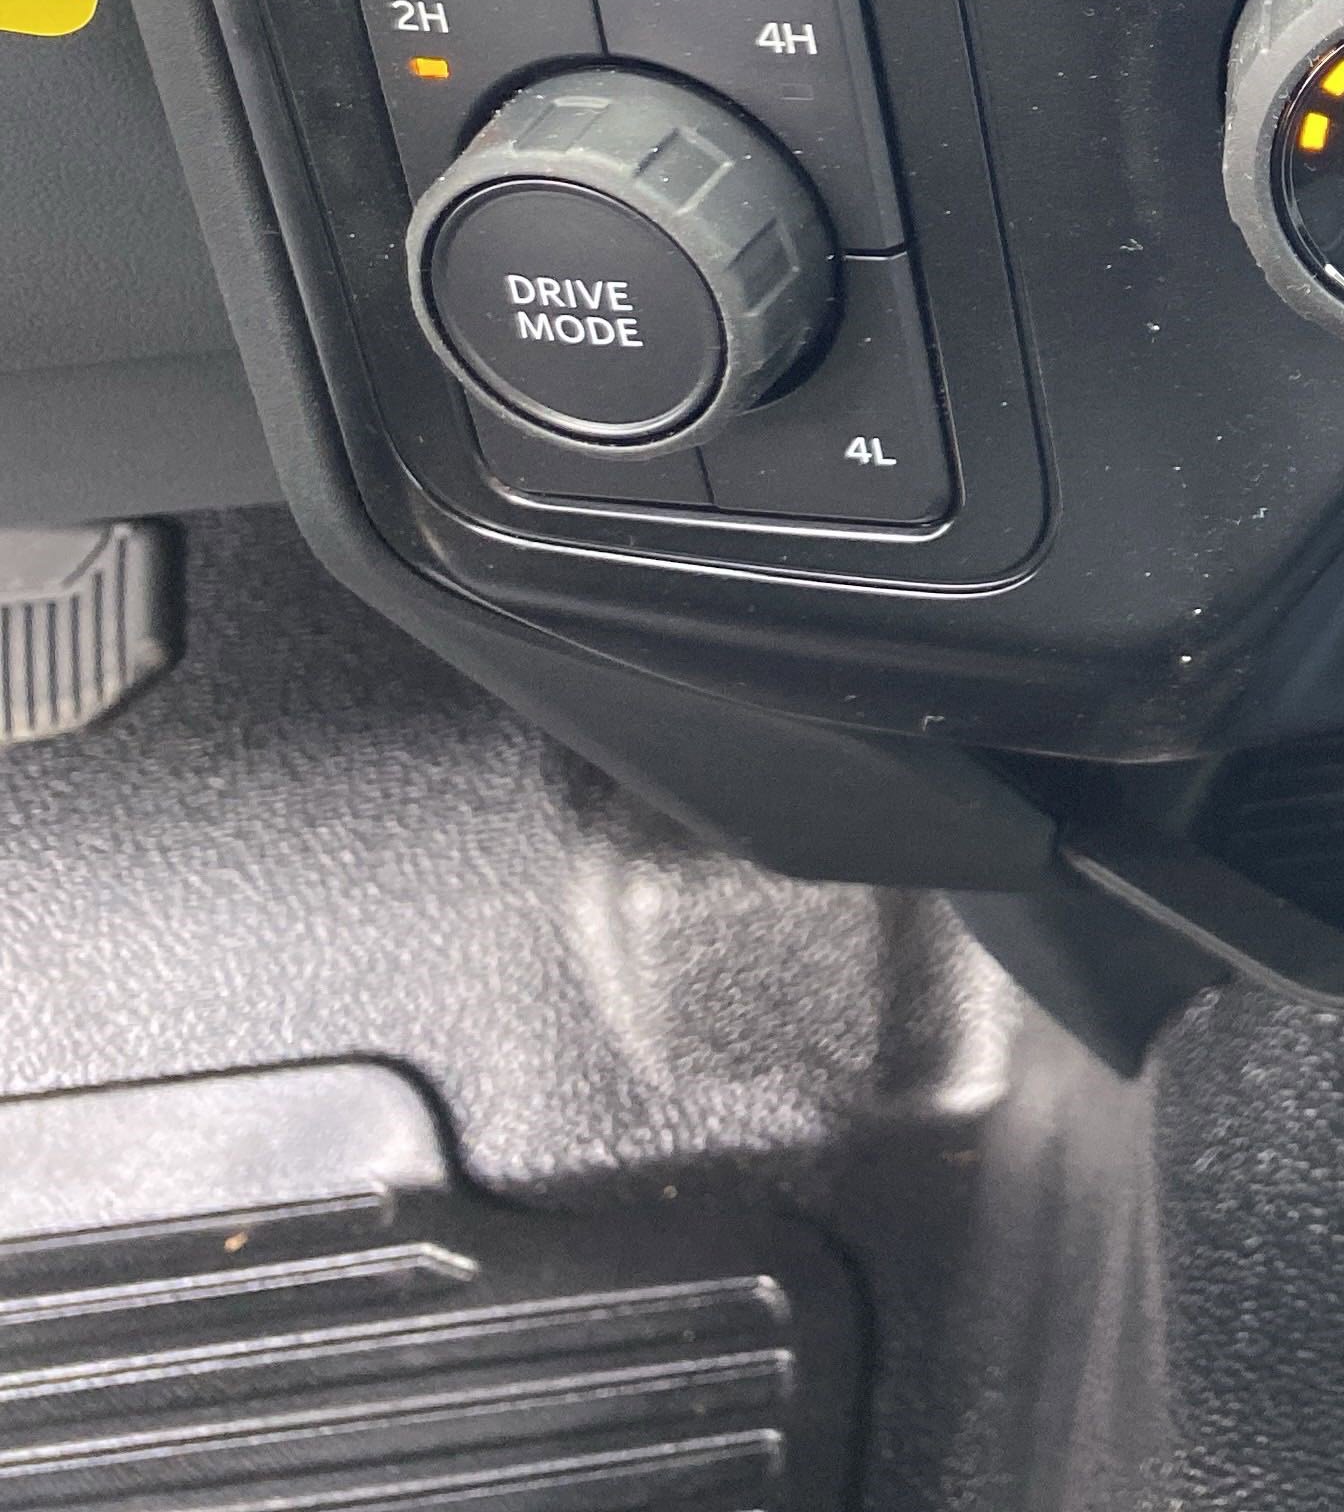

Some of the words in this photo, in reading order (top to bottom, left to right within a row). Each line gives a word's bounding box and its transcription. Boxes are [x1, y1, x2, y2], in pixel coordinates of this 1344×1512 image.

[754, 21, 819, 56] 4H
[505, 273, 634, 312] DRIVE
[515, 310, 645, 348] MODE
[844, 435, 898, 467] 4L
